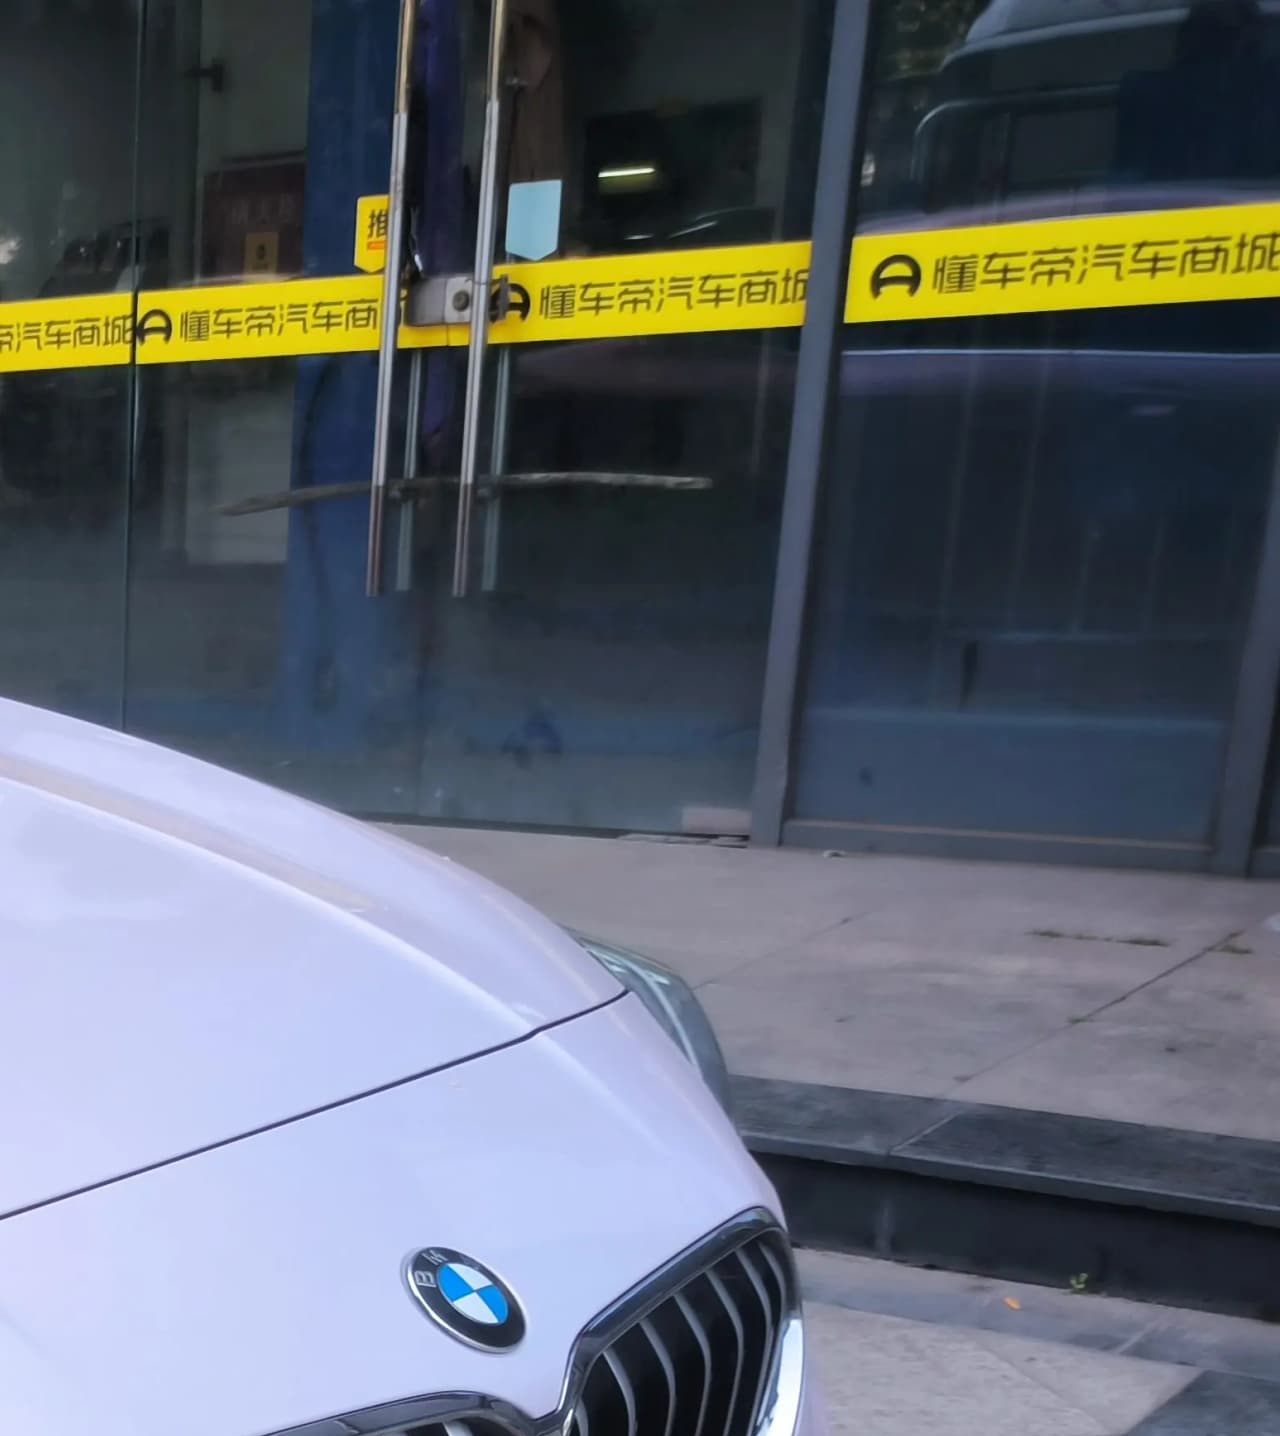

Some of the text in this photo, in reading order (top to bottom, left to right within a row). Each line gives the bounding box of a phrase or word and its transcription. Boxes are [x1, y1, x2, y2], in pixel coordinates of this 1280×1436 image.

[933, 232, 1280, 293] 懂车帝汽车商城
[180, 296, 406, 343] 懂车帝汽车商
